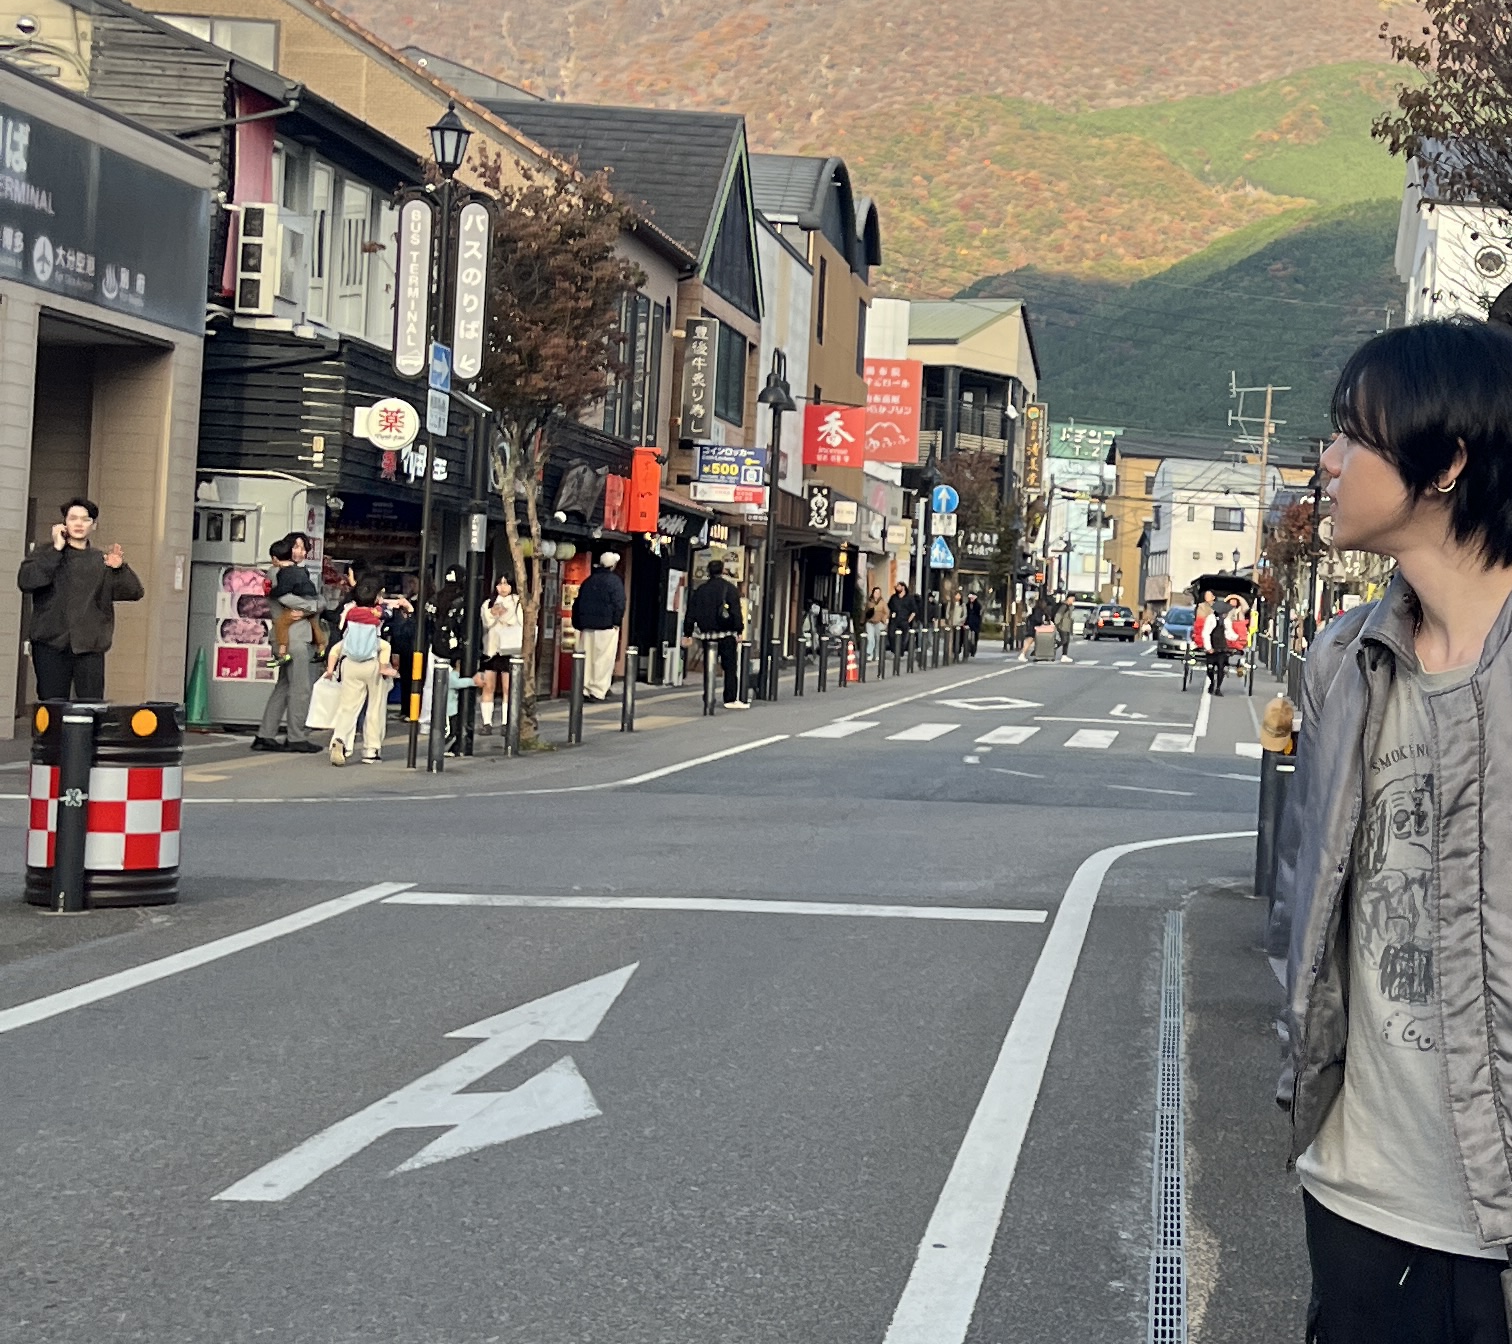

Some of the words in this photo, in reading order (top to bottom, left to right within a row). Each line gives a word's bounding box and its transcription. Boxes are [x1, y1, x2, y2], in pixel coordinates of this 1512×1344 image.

[410, 209, 422, 245] BUS
[459, 213, 486, 340] バスのりば
[406, 251, 420, 346] TERMINAL
[817, 410, 856, 448] 香
[702, 446, 756, 457] コインロッカー
